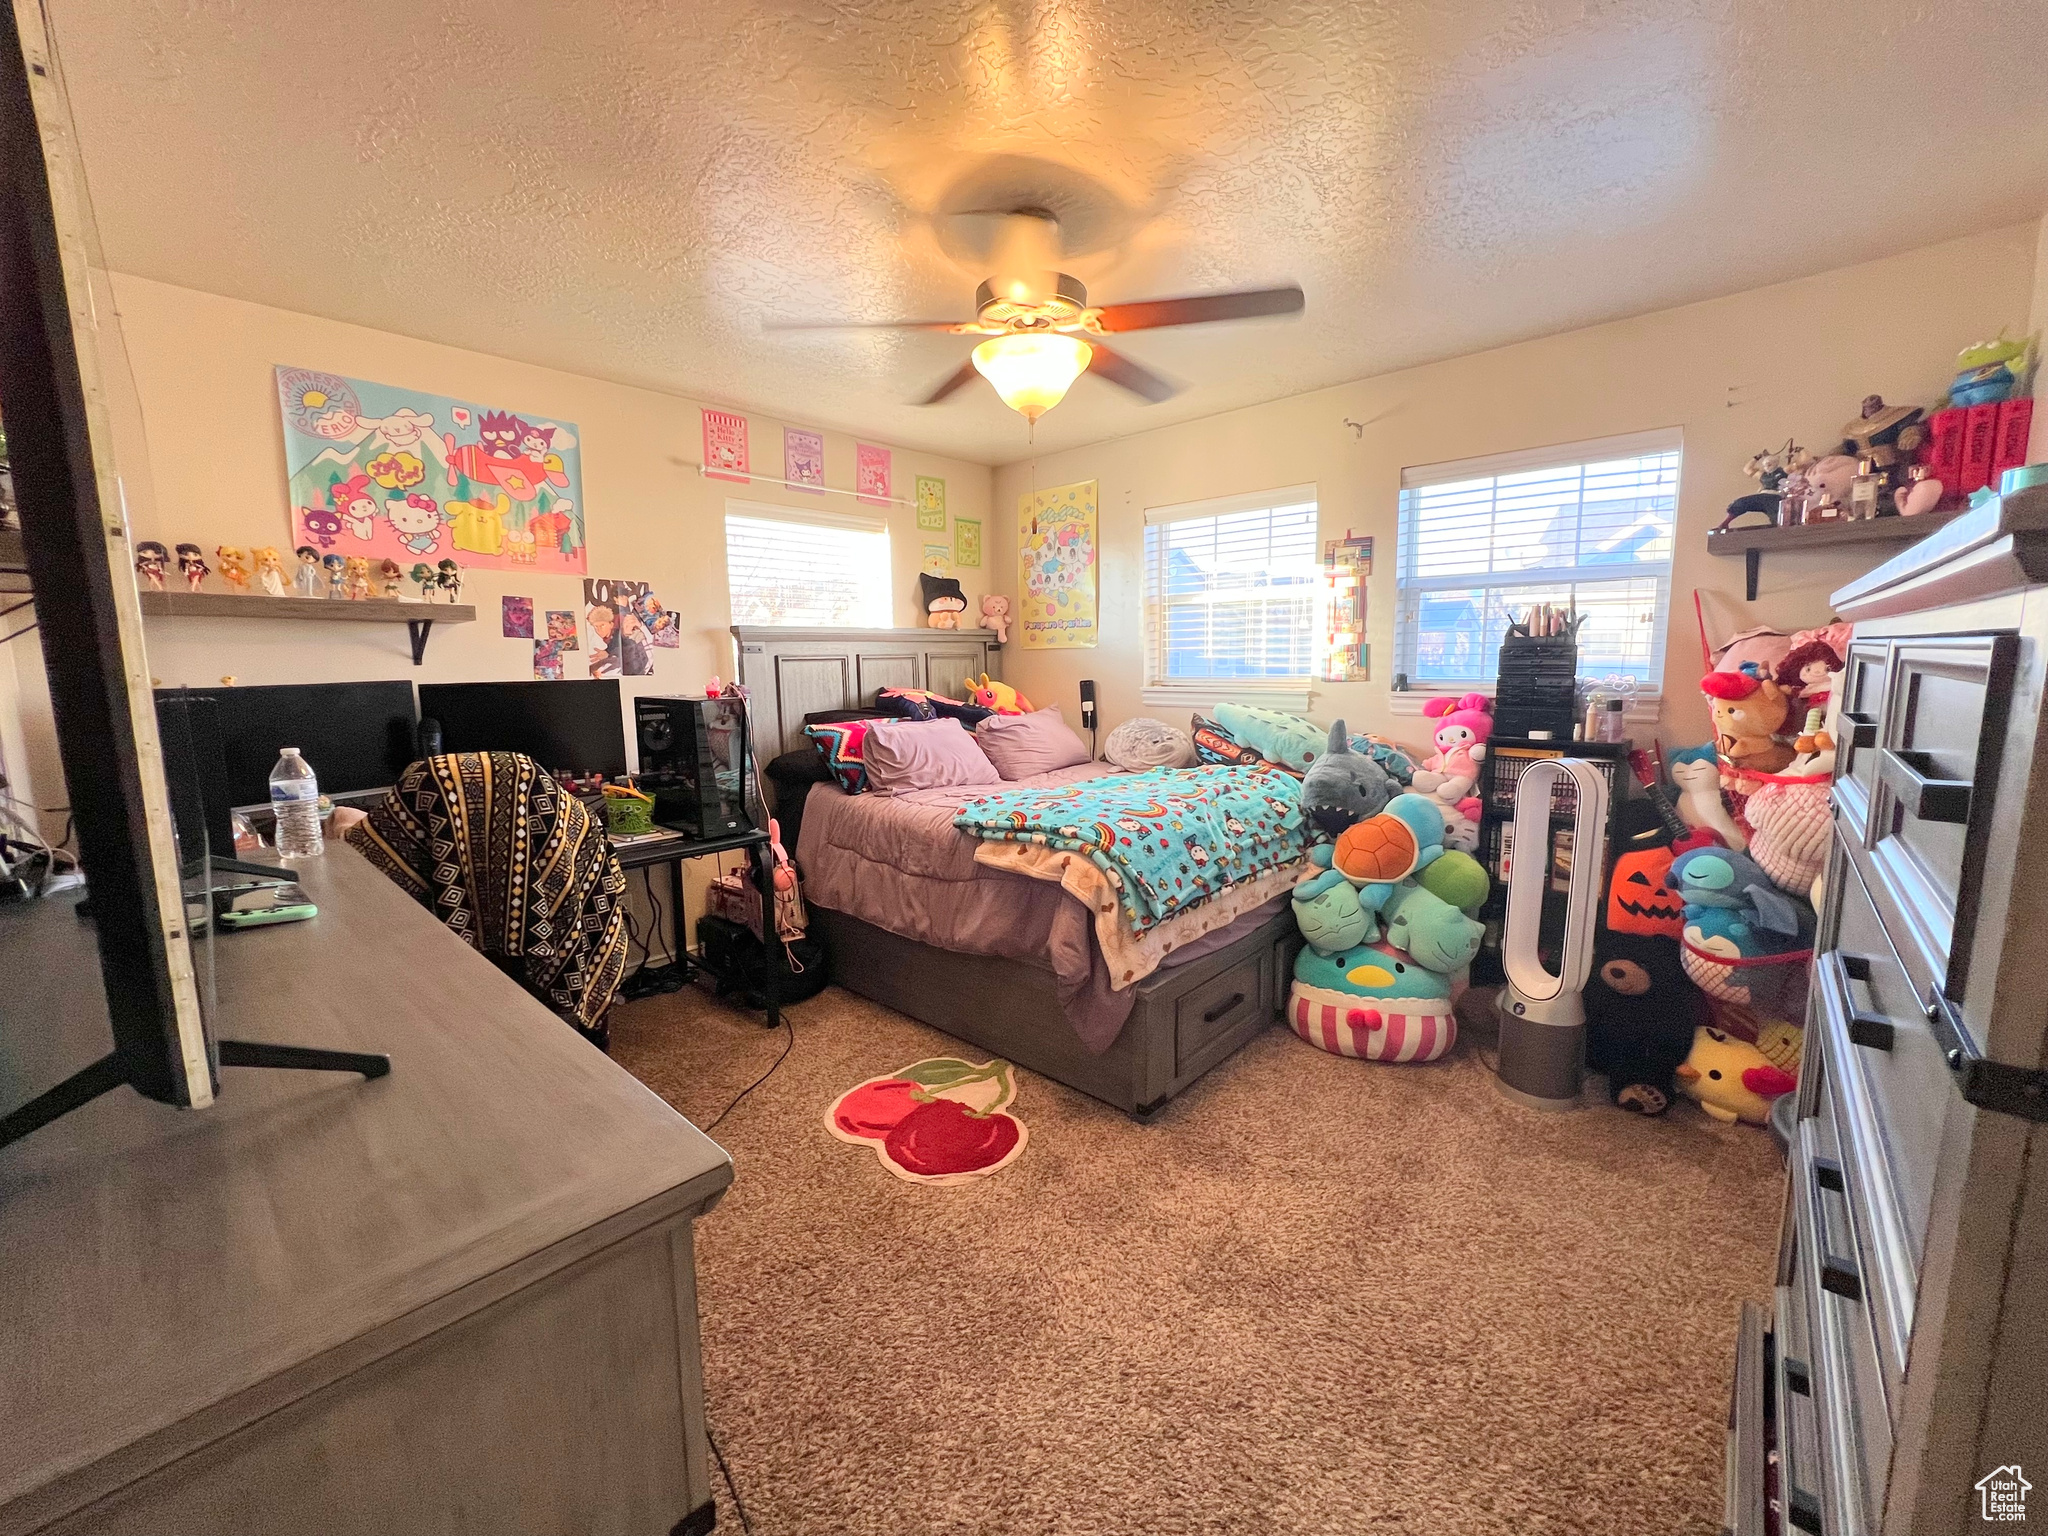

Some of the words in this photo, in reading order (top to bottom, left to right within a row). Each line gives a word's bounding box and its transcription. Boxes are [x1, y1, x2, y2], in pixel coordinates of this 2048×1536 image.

[281, 371, 342, 407] HAPPINESS
[297, 401, 355, 434] OVERLOAD
[717, 426, 735, 436] Hello
[717, 433, 735, 443] Kitty
[1024, 621, 1057, 631] Peropero
[1058, 618, 1091, 630] Sparkles
